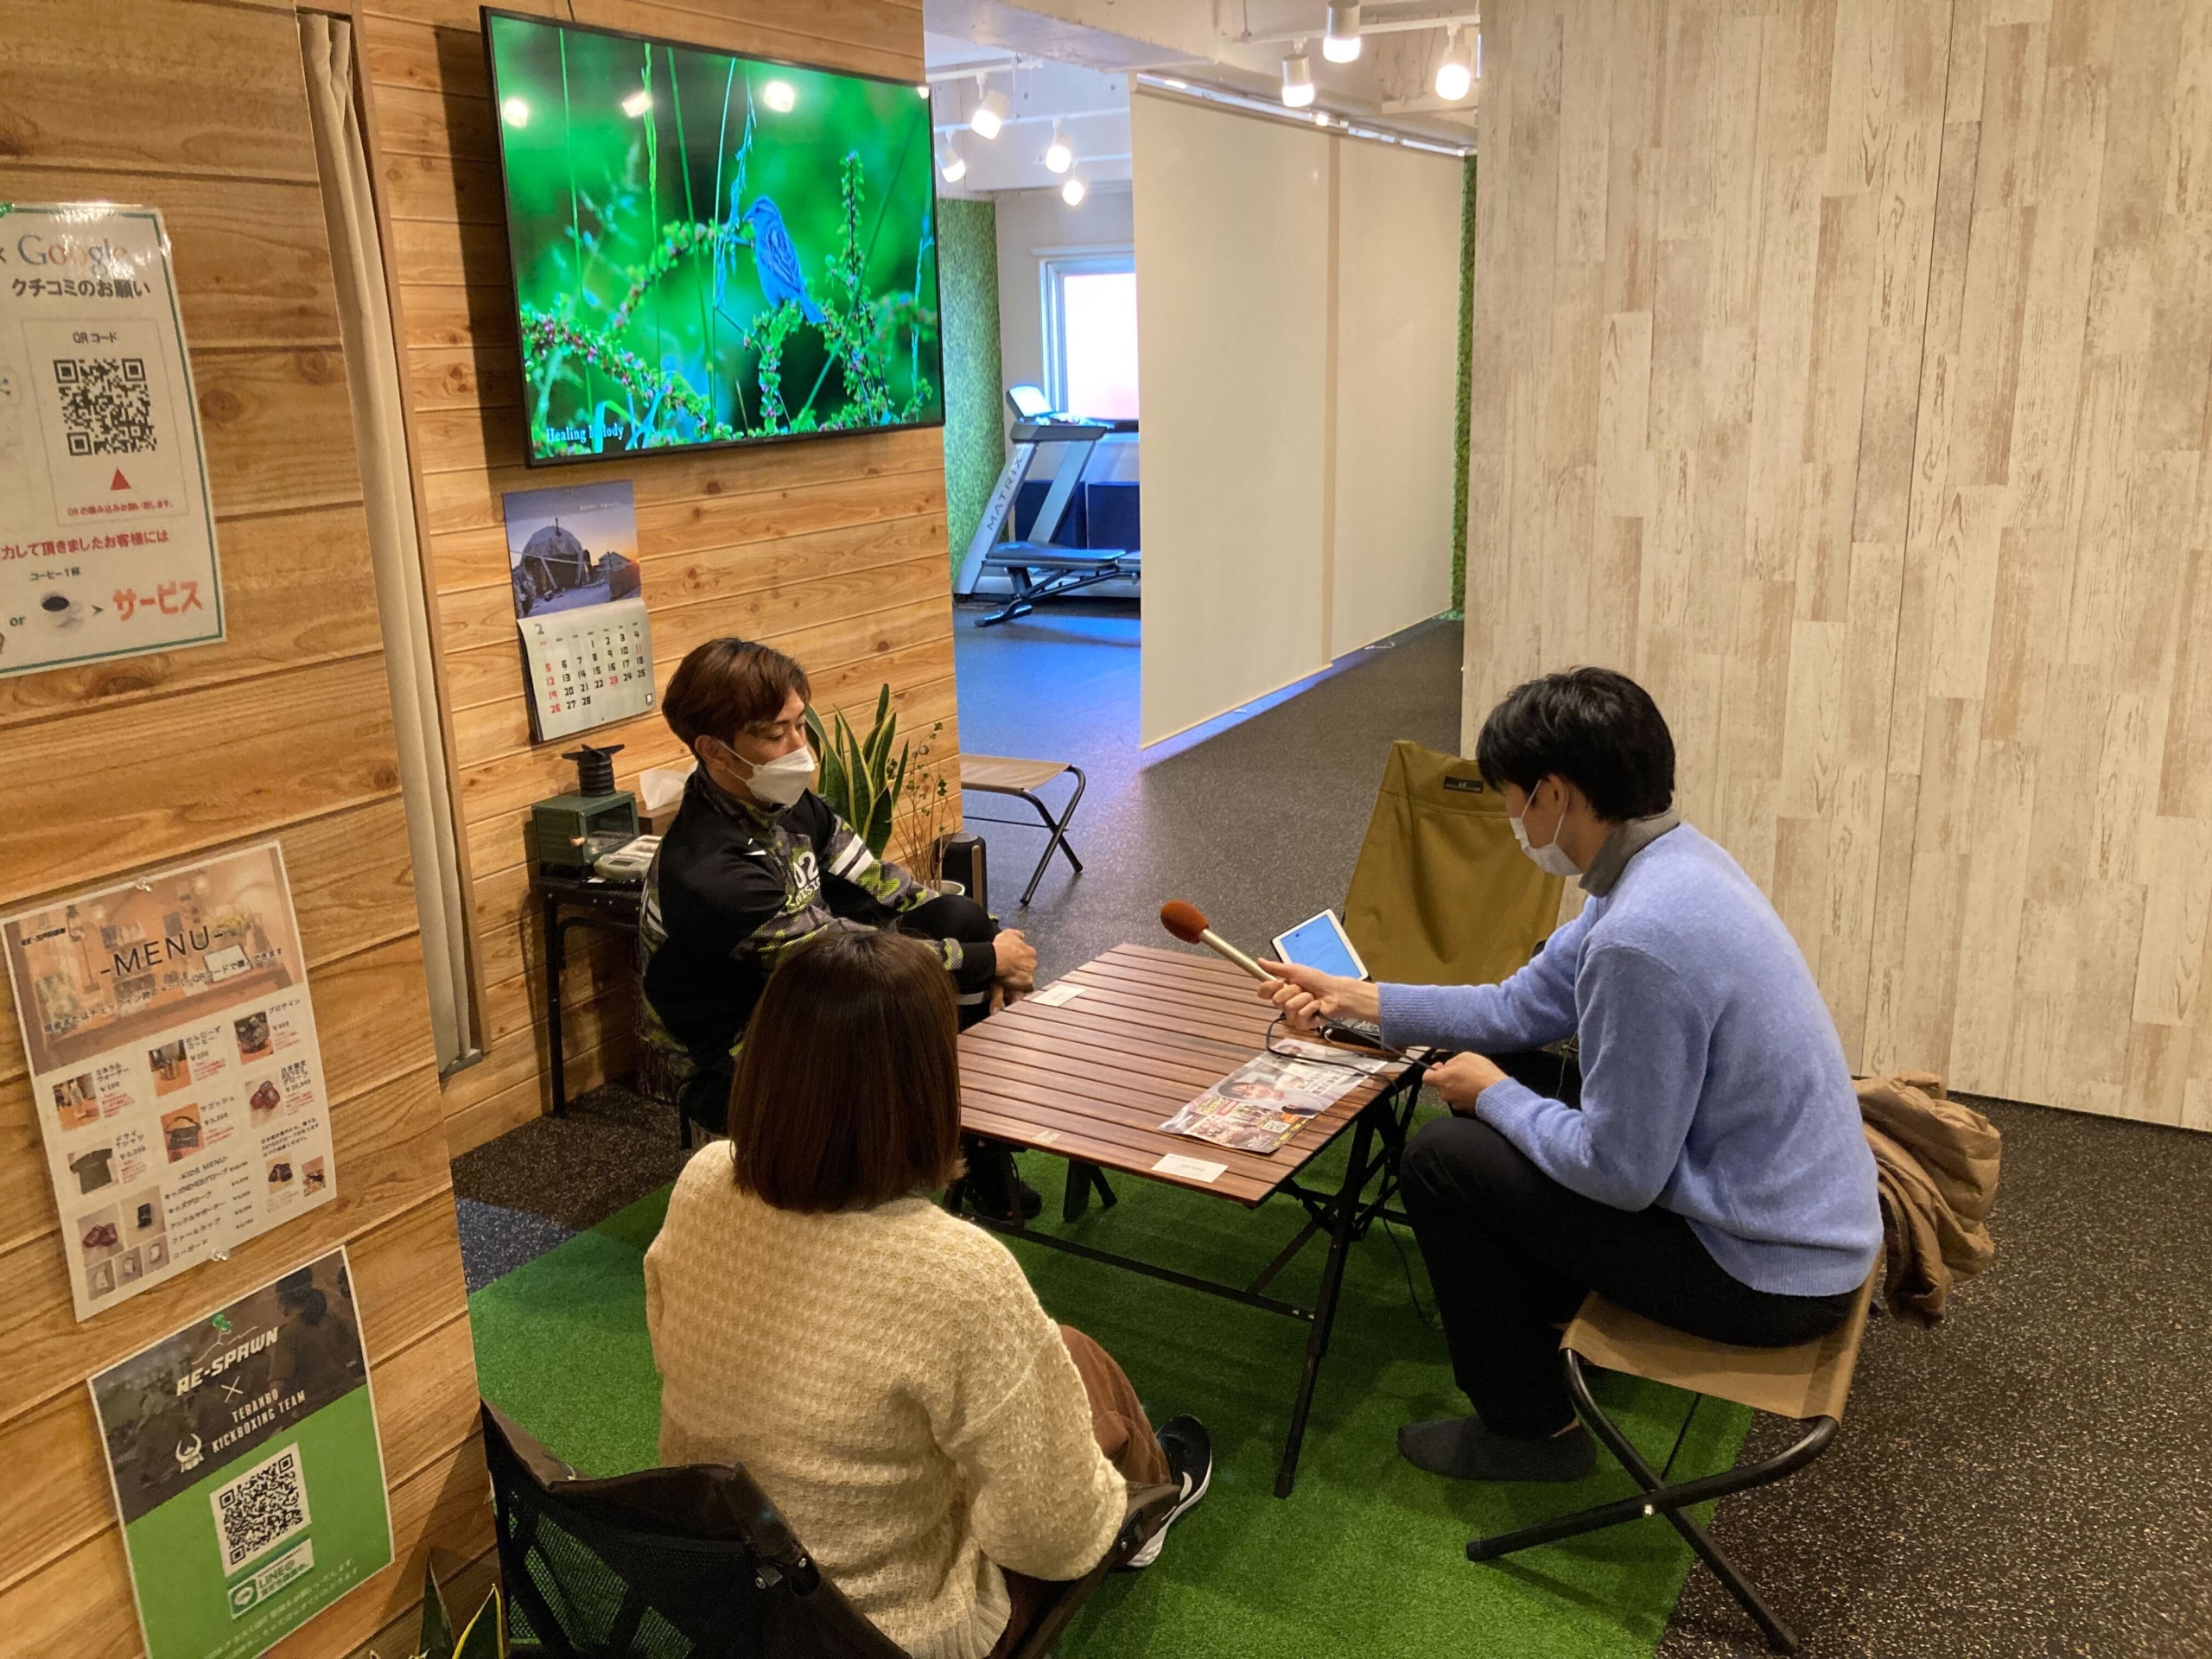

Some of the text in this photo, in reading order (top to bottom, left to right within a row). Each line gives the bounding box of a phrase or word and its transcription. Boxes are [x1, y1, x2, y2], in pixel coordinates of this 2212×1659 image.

[17, 234, 128, 277] Google
[12, 278, 151, 298] クチコミのお願い
[546, 426, 587, 444] Healing
[988, 458, 1022, 530] MATRIX
[112, 581, 203, 621] サービス
[10, 615, 26, 627] or
[535, 623, 544, 635] 2
[620, 646, 629, 656] 10
[636, 644, 642, 655] 11
[546, 656, 644, 687] 12 13 14 15 16 17 18
[549, 669, 645, 700] 19 20 21 22 23 24 25
[550, 696, 591, 714] 26 27 28
[176, 1325, 278, 1396] RE-SPAWN
[212, 1390, 305, 1452] KICKBOXING TEAM
